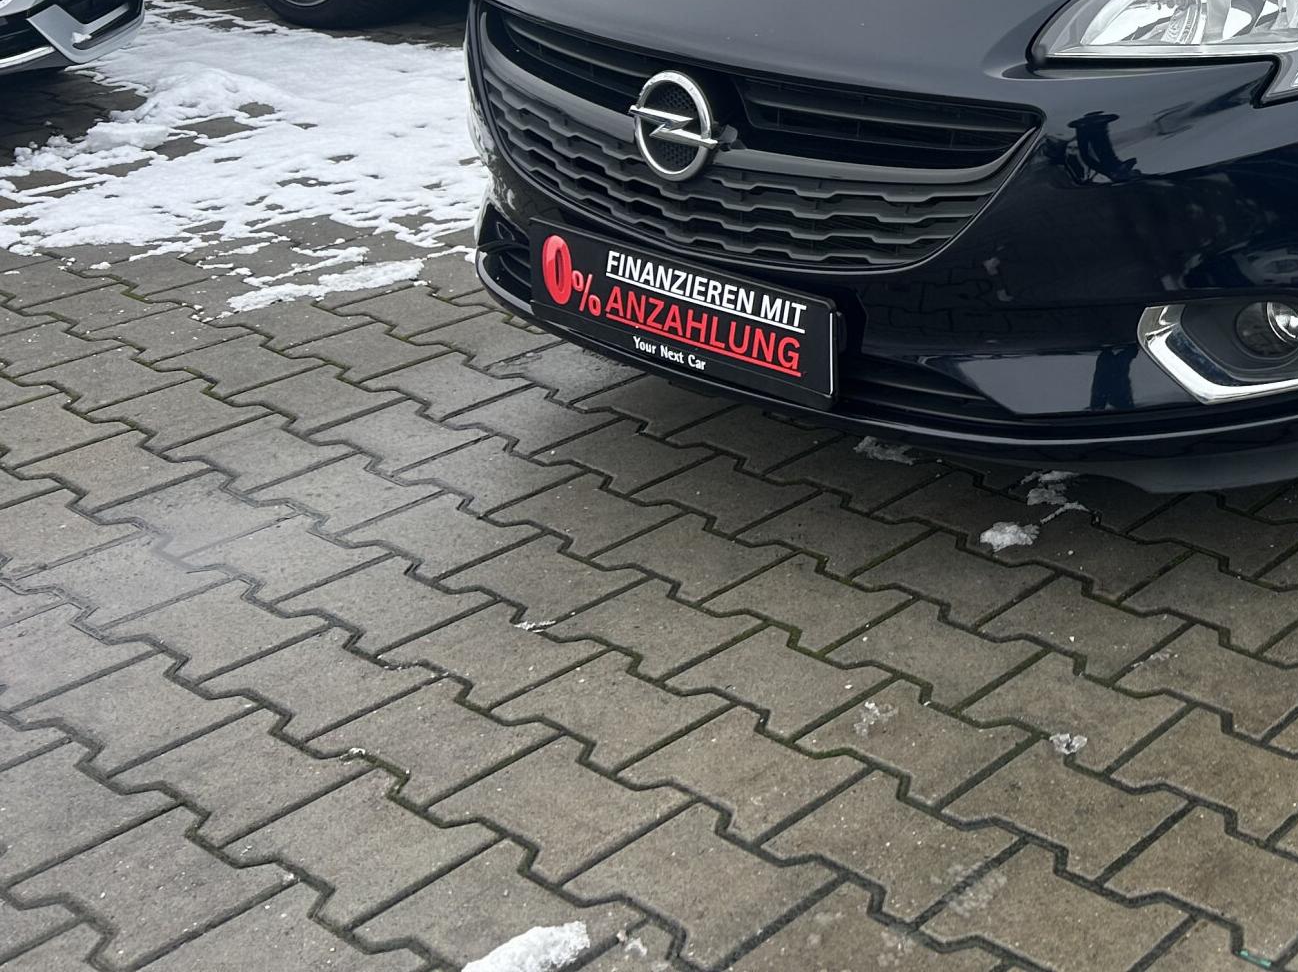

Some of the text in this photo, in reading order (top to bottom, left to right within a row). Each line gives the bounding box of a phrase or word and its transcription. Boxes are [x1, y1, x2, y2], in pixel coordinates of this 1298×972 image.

[542, 235, 601, 317] 0%
[607, 250, 807, 327] FINANZIEREN MIT
[605, 285, 801, 370] ANZAHLUNG
[633, 336, 706, 370] Your Next Car
